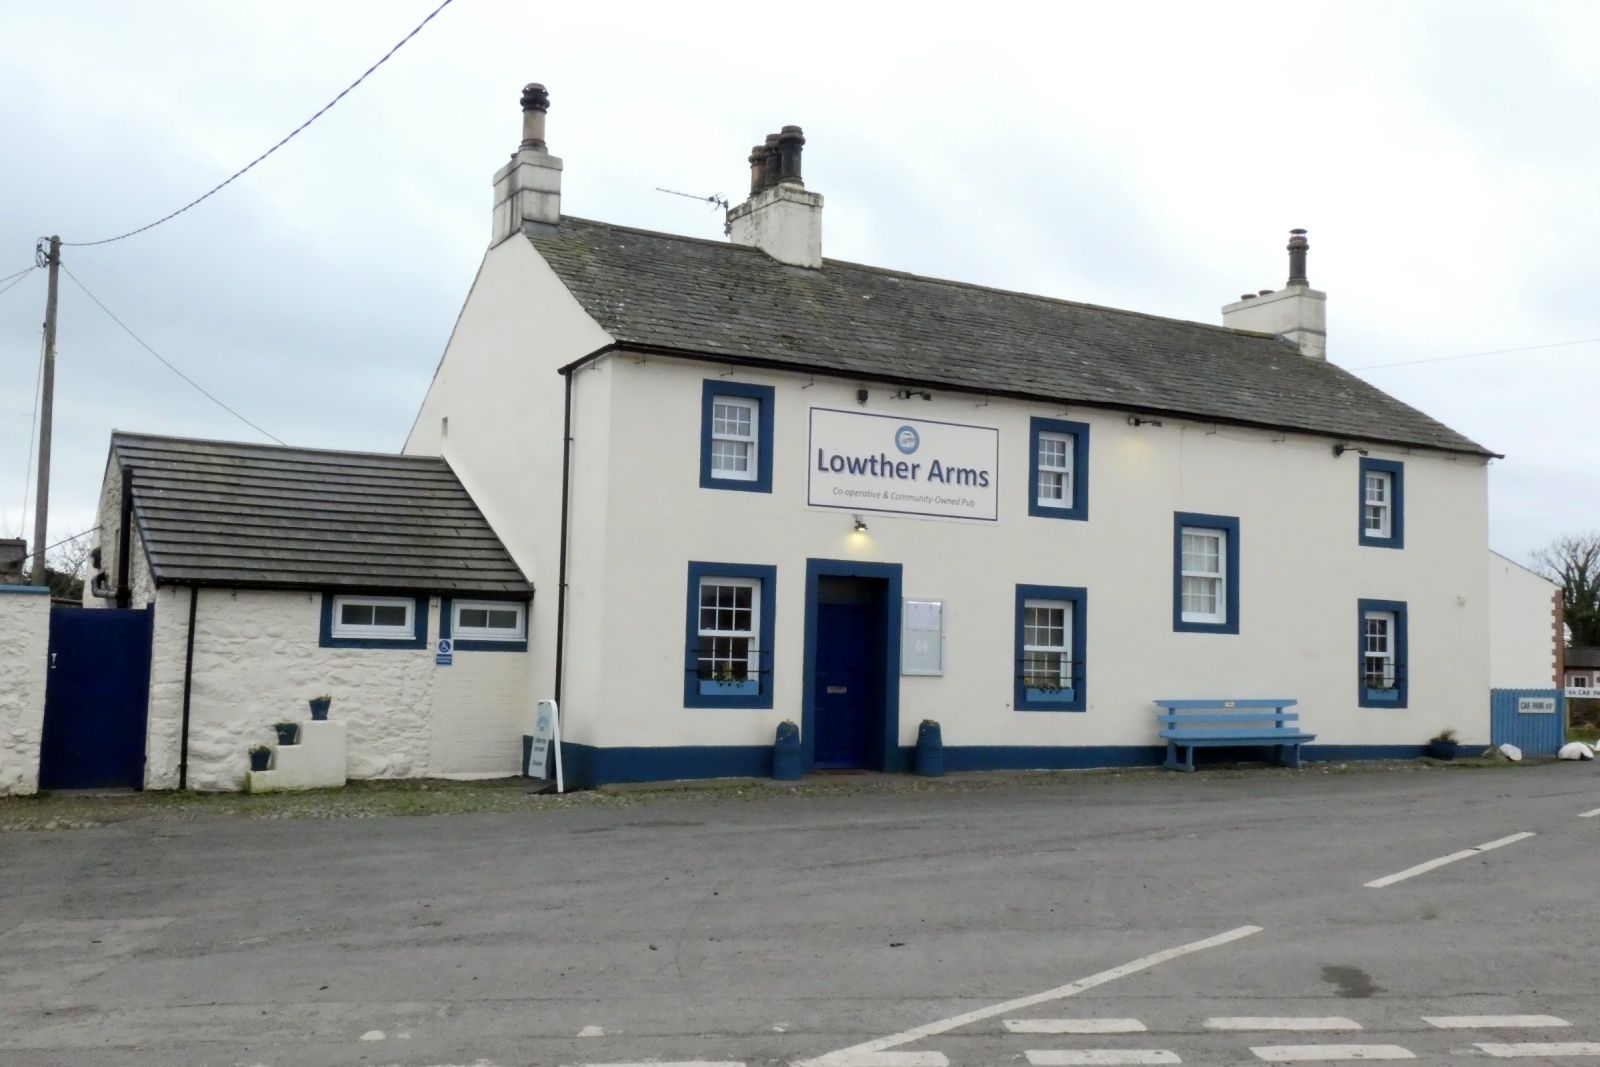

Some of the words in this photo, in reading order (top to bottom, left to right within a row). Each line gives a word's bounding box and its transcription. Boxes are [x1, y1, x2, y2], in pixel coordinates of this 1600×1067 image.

[818, 448, 920, 480] Lowther
[927, 459, 989, 487] Arms
[833, 487, 881, 499] Co-operative
[882, 490, 888, 499] &
[961, 499, 975, 507] Pub
[1521, 701, 1530, 709] CAR
